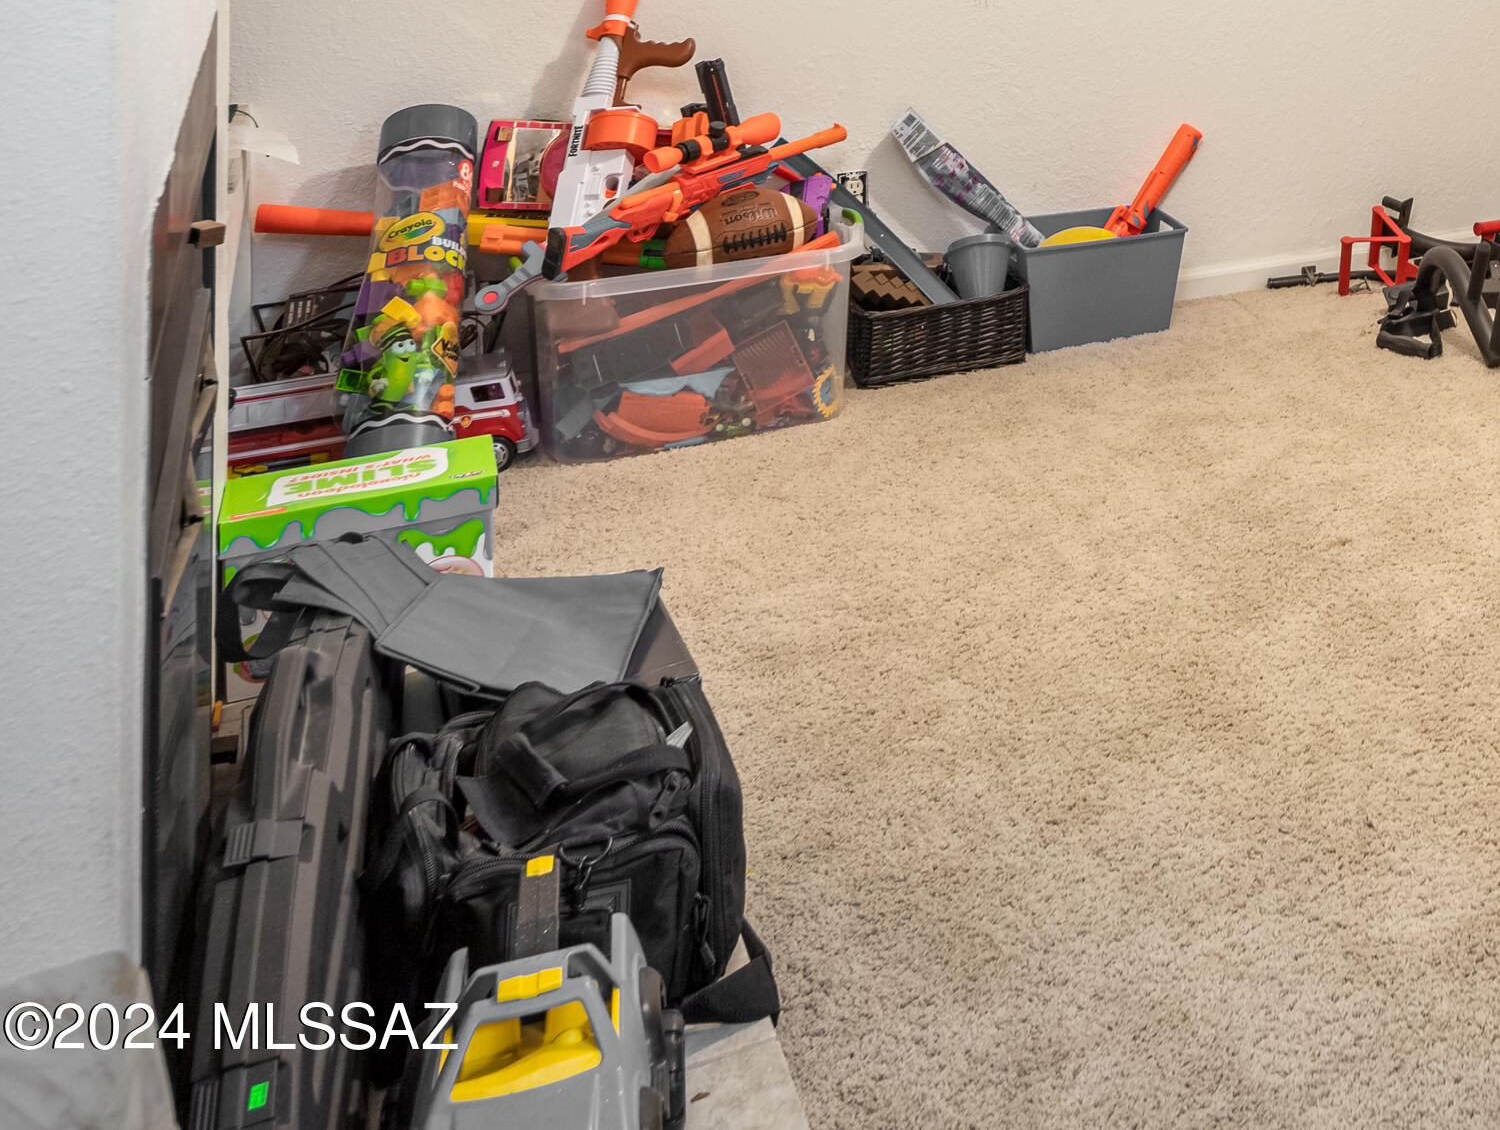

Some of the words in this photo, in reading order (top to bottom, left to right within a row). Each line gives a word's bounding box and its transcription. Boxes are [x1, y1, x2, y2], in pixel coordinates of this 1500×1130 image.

[568, 125, 584, 158] FORTNITE
[387, 218, 433, 240] Crayola
[282, 459, 437, 496] SLIME
